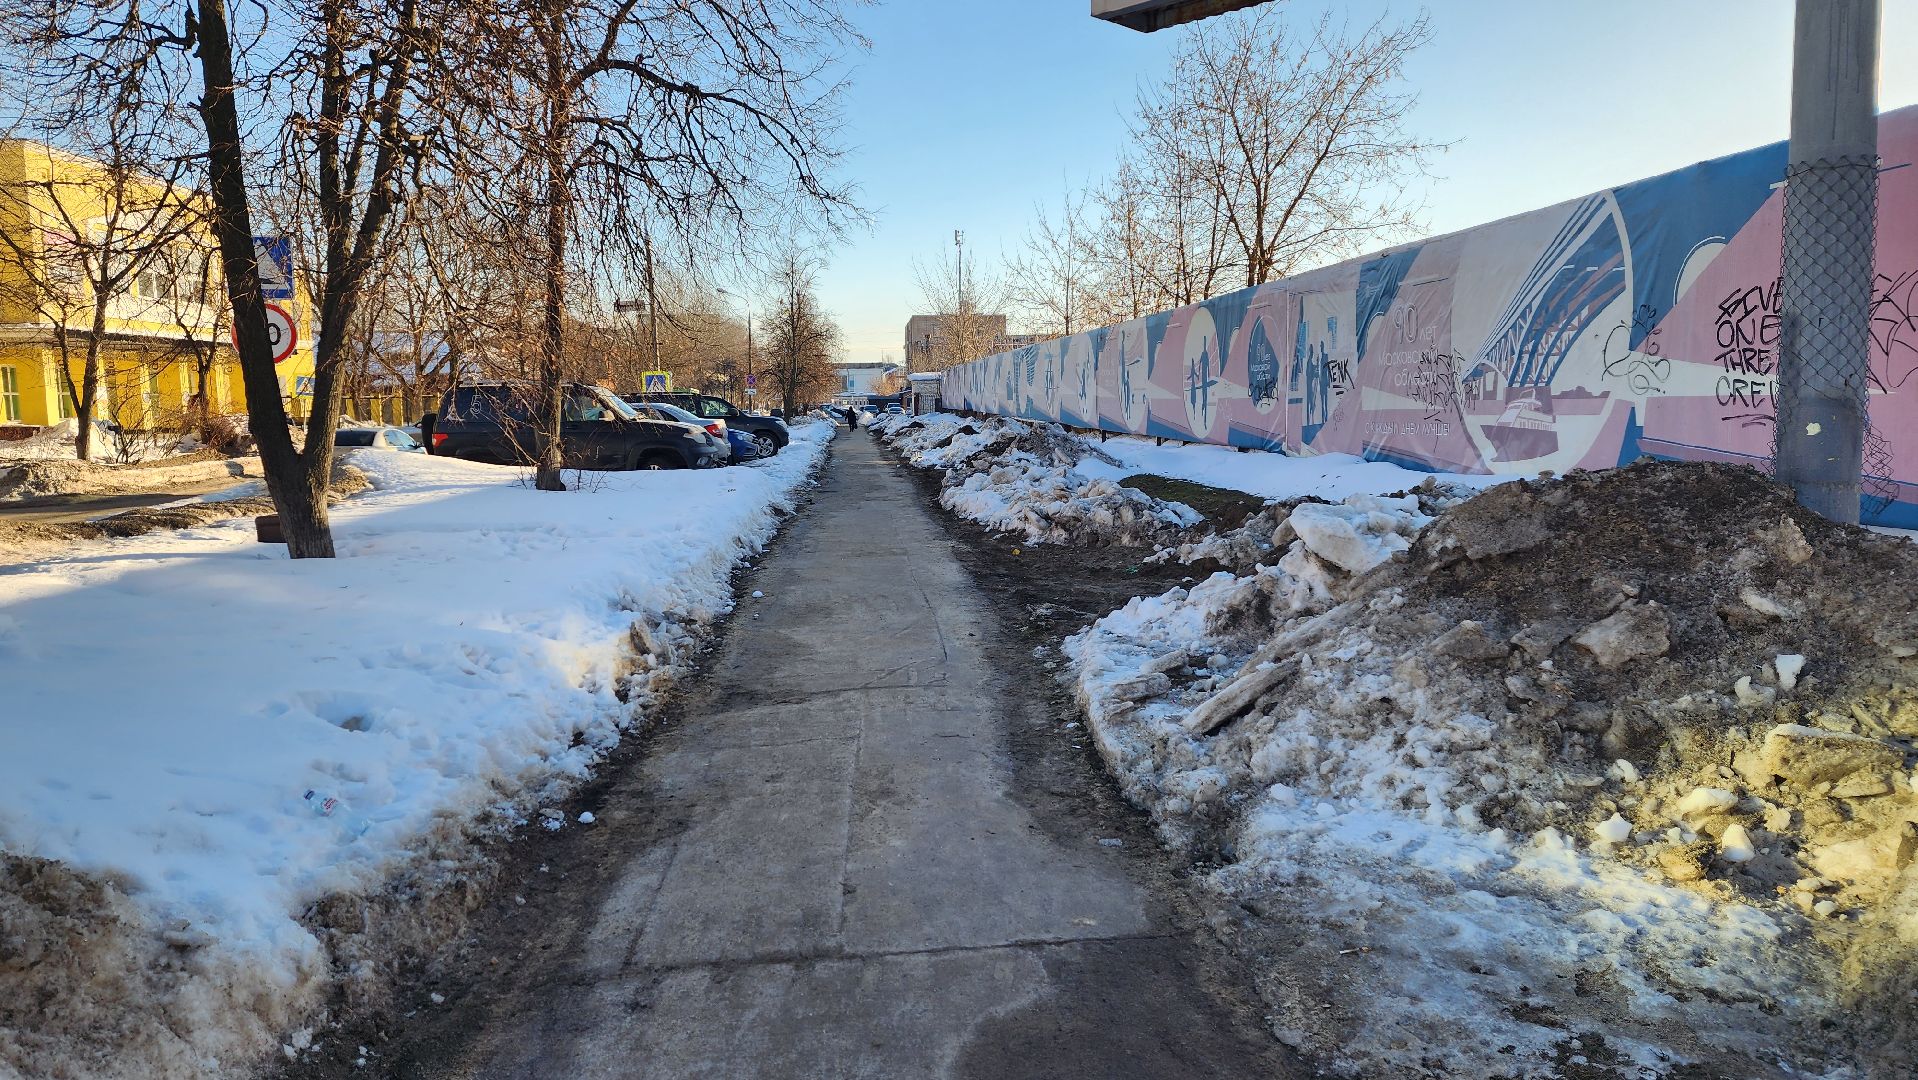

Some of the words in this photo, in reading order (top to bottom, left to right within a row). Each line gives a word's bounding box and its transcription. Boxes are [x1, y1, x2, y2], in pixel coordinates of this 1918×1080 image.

[1393, 303, 1419, 344] 90
[1716, 314, 1781, 348] ONE
[1716, 375, 1778, 409] CRE
